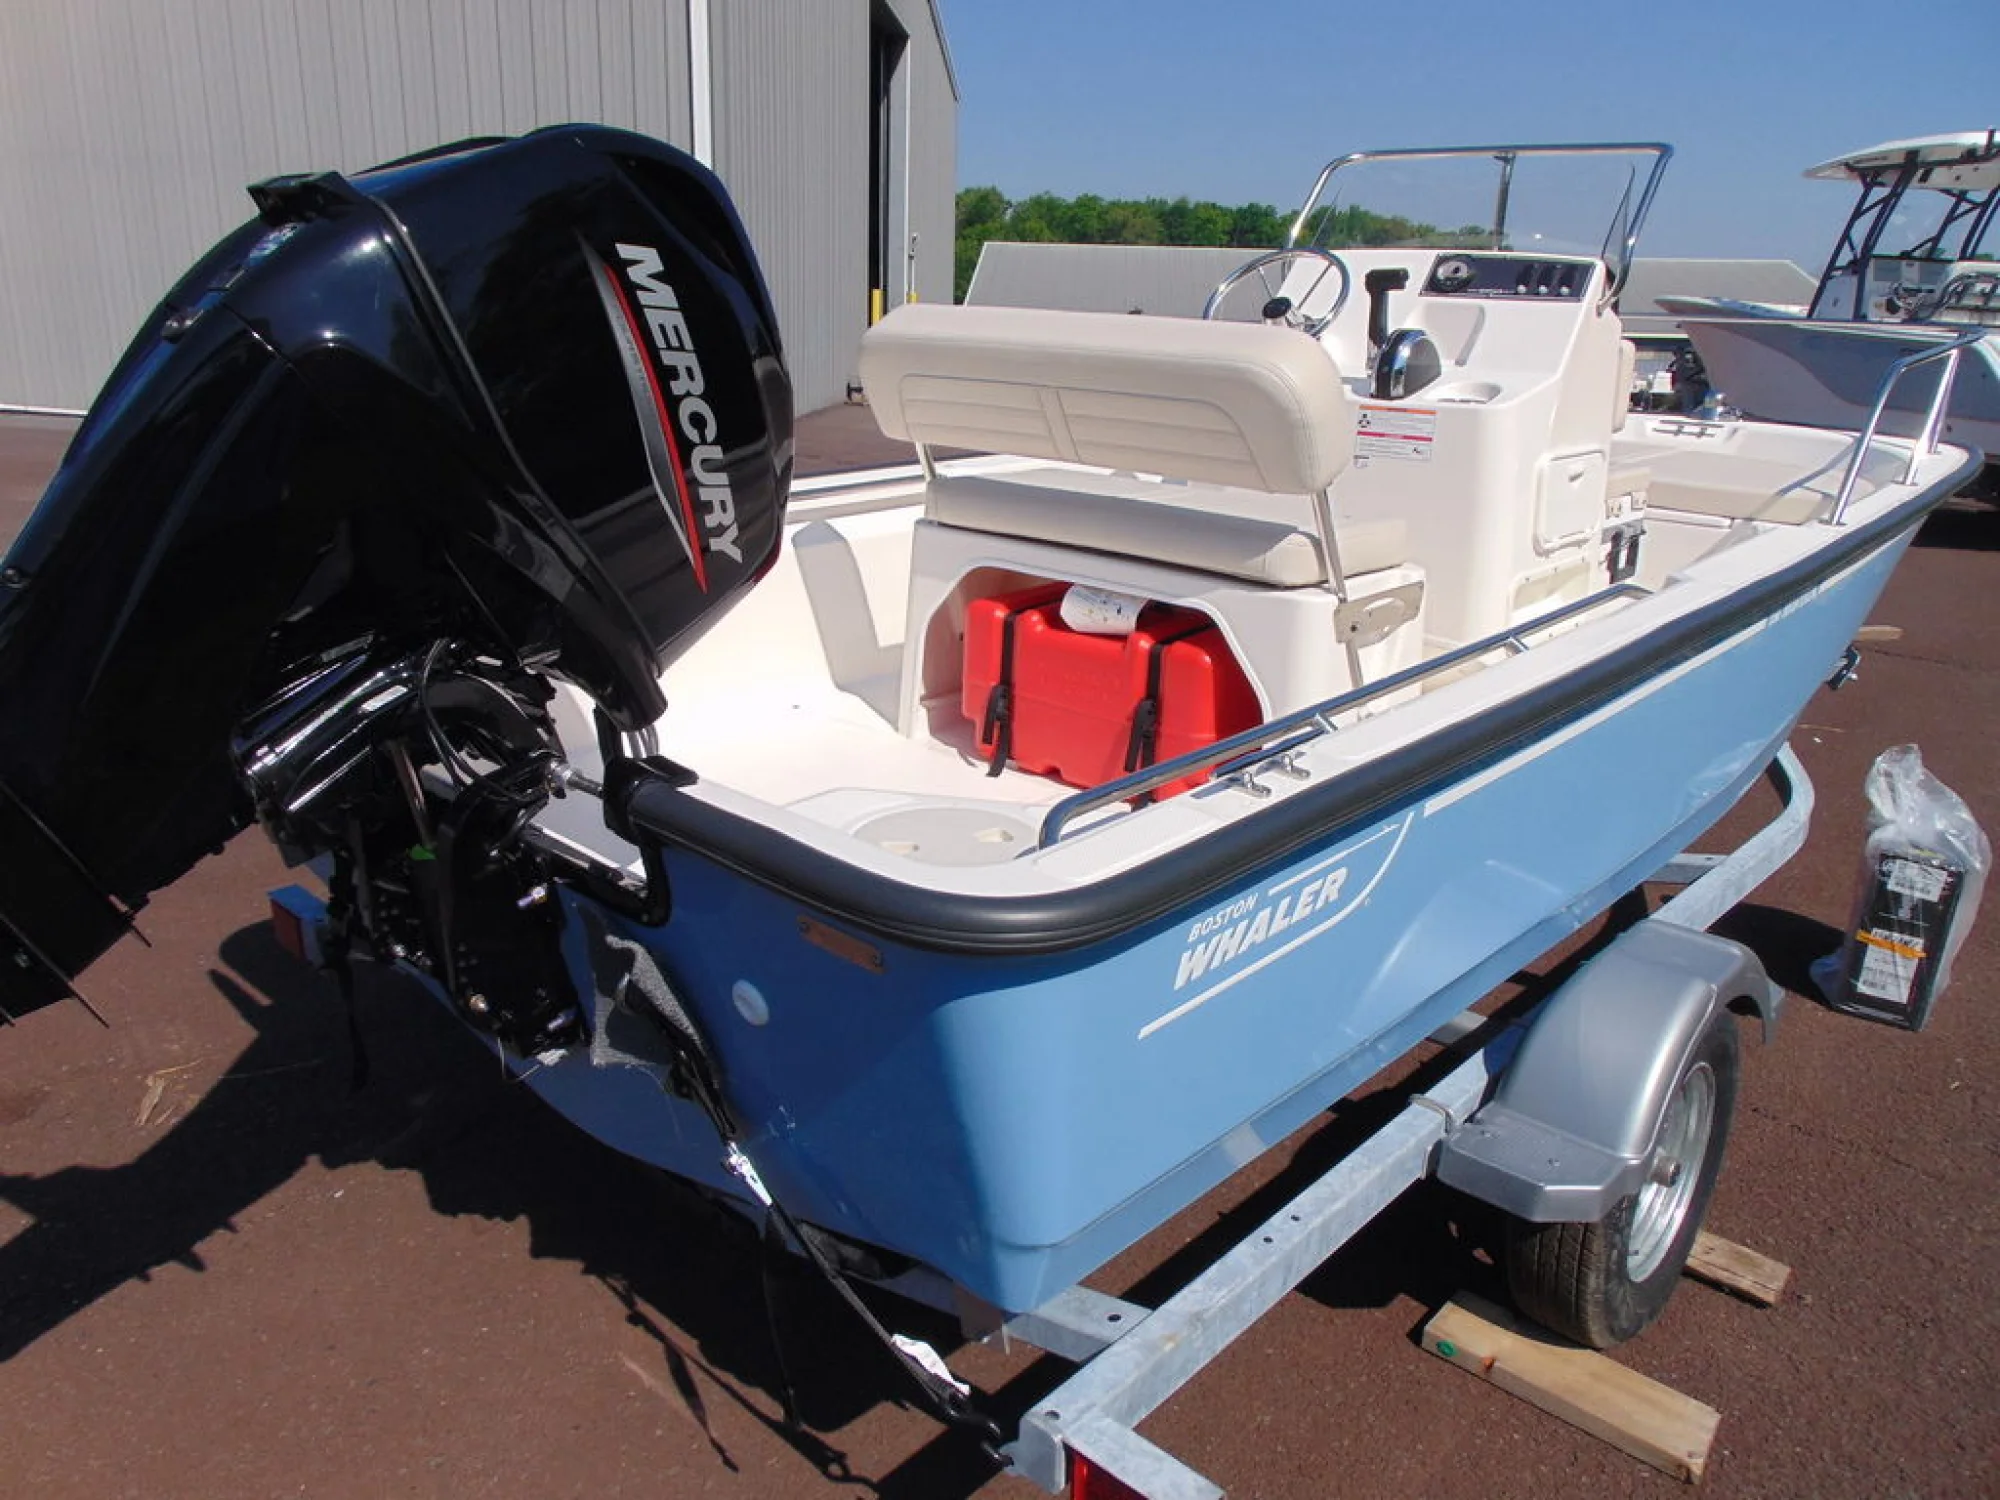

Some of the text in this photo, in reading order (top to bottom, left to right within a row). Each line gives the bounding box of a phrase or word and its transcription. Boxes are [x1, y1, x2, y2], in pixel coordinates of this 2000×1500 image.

[615, 243, 742, 564] MERCURY
[1174, 866, 1348, 990] WHALER
[1187, 892, 1259, 943] BOSTON
